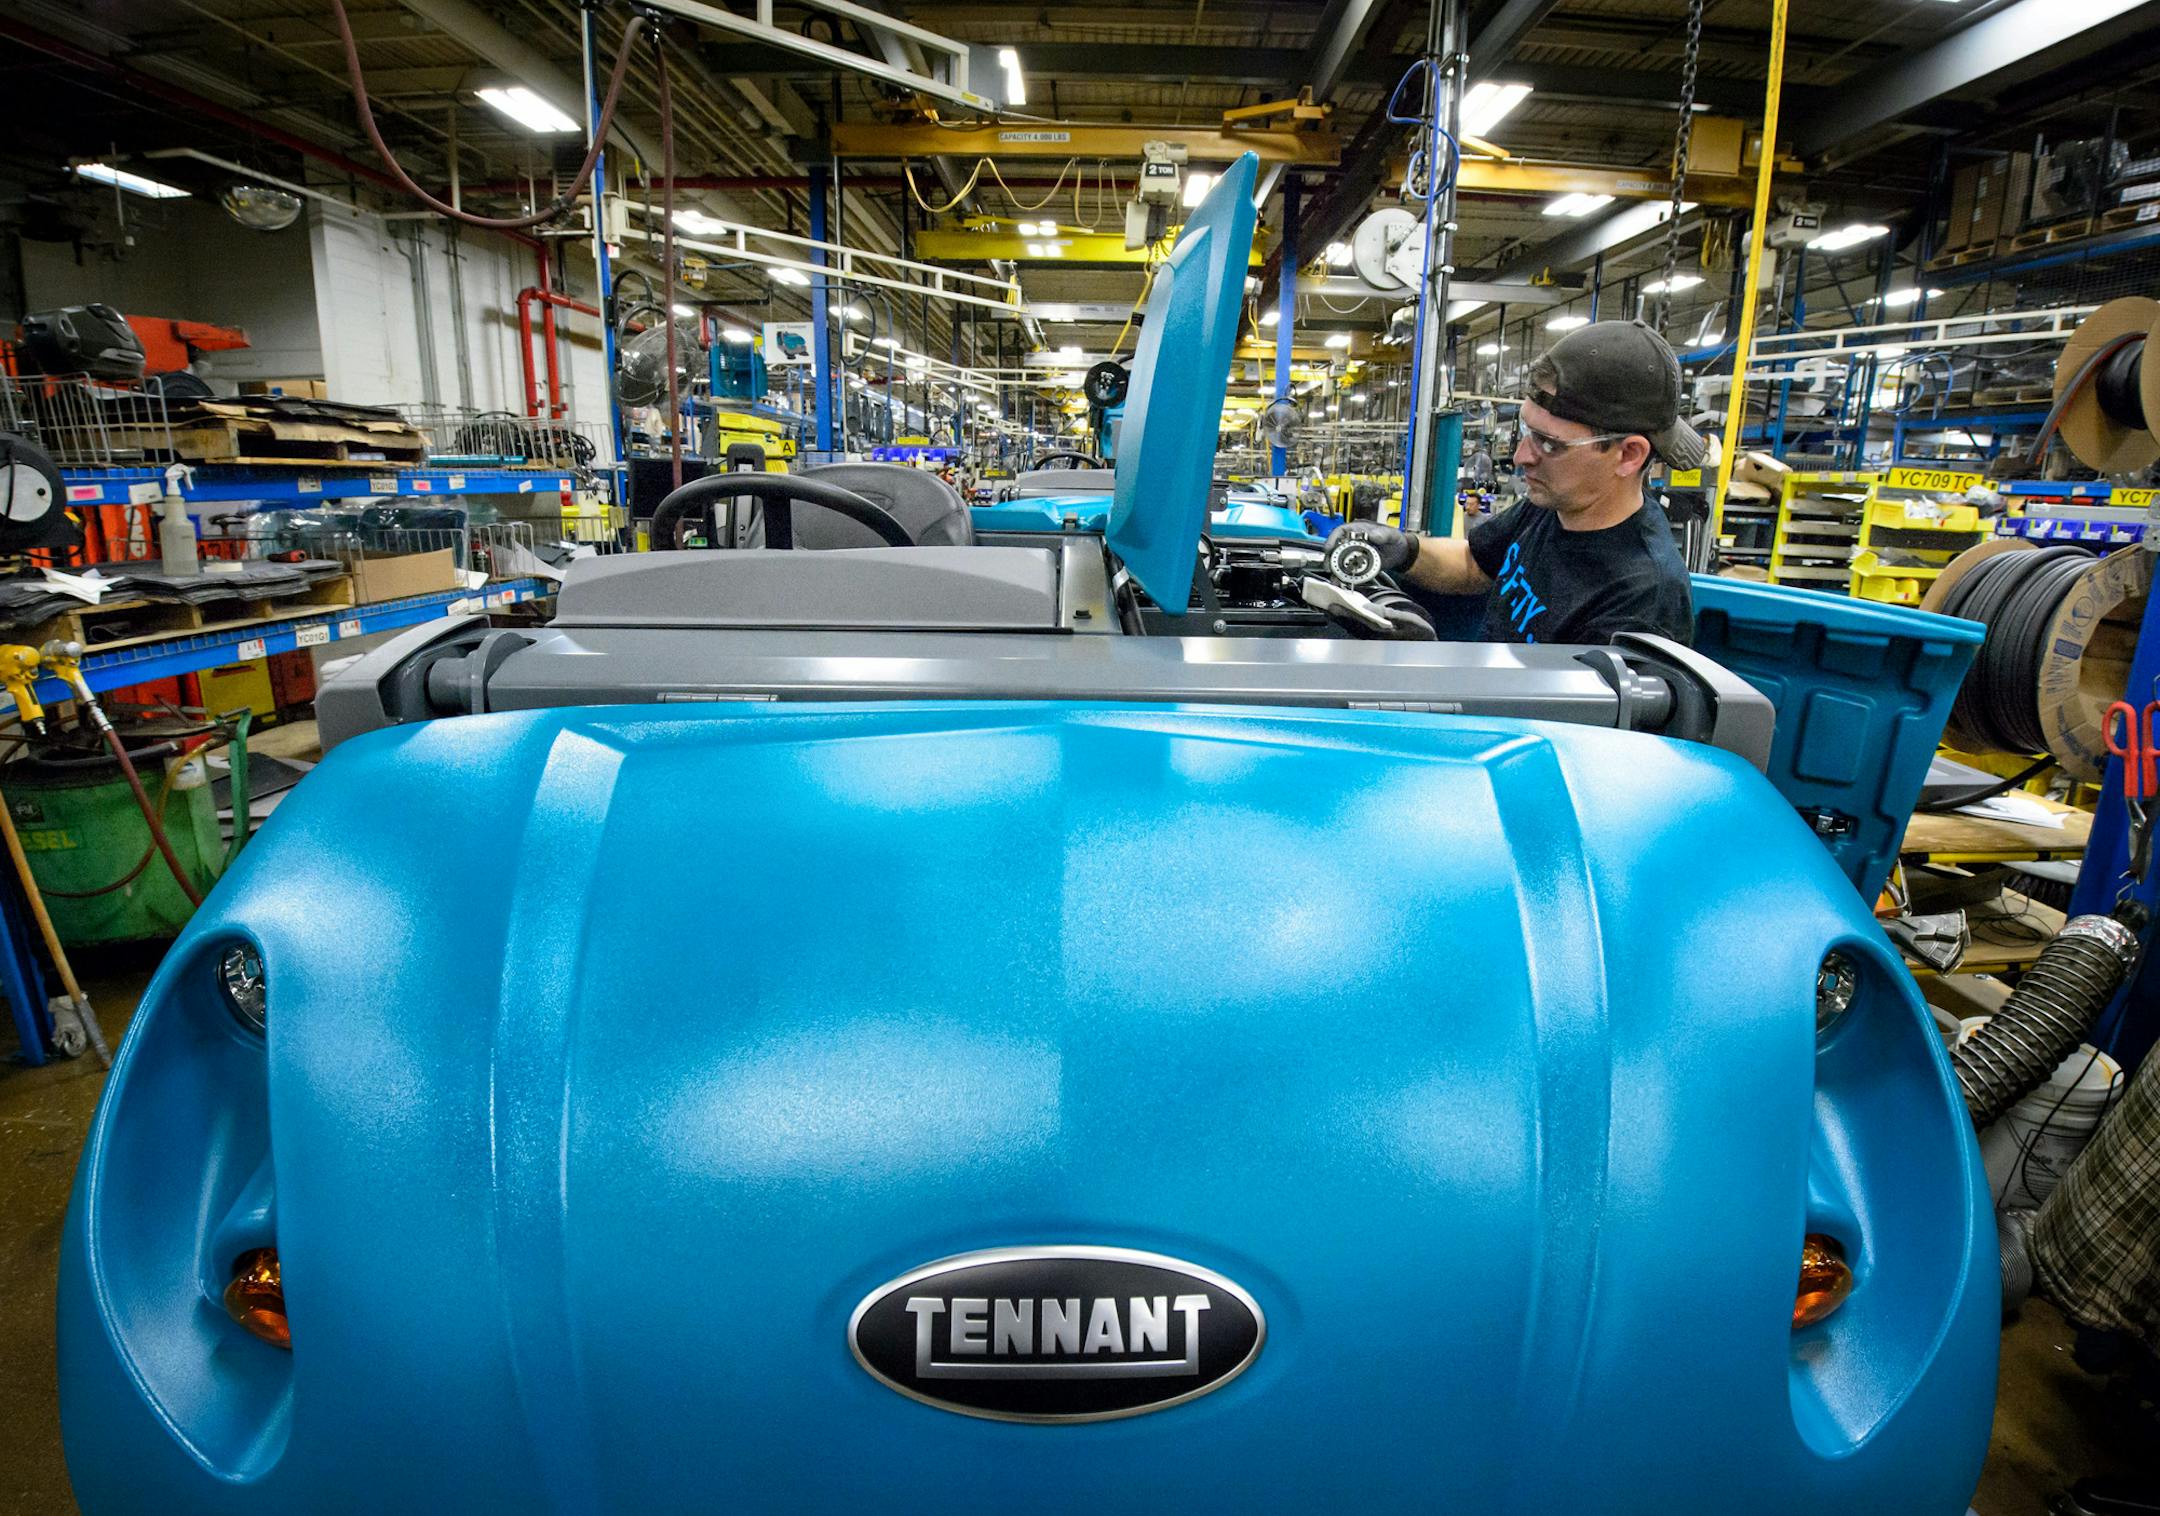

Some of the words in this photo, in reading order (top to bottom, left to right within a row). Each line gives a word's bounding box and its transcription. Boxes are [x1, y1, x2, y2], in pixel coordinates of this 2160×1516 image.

[999, 132, 1031, 141] CAPACITY
[1148, 164, 1157, 175] 2
[1158, 166, 1174, 175] TON
[1795, 216, 1803, 226] 2
[783, 441, 792, 453] A
[905, 1294, 1211, 1379] TENNANT
